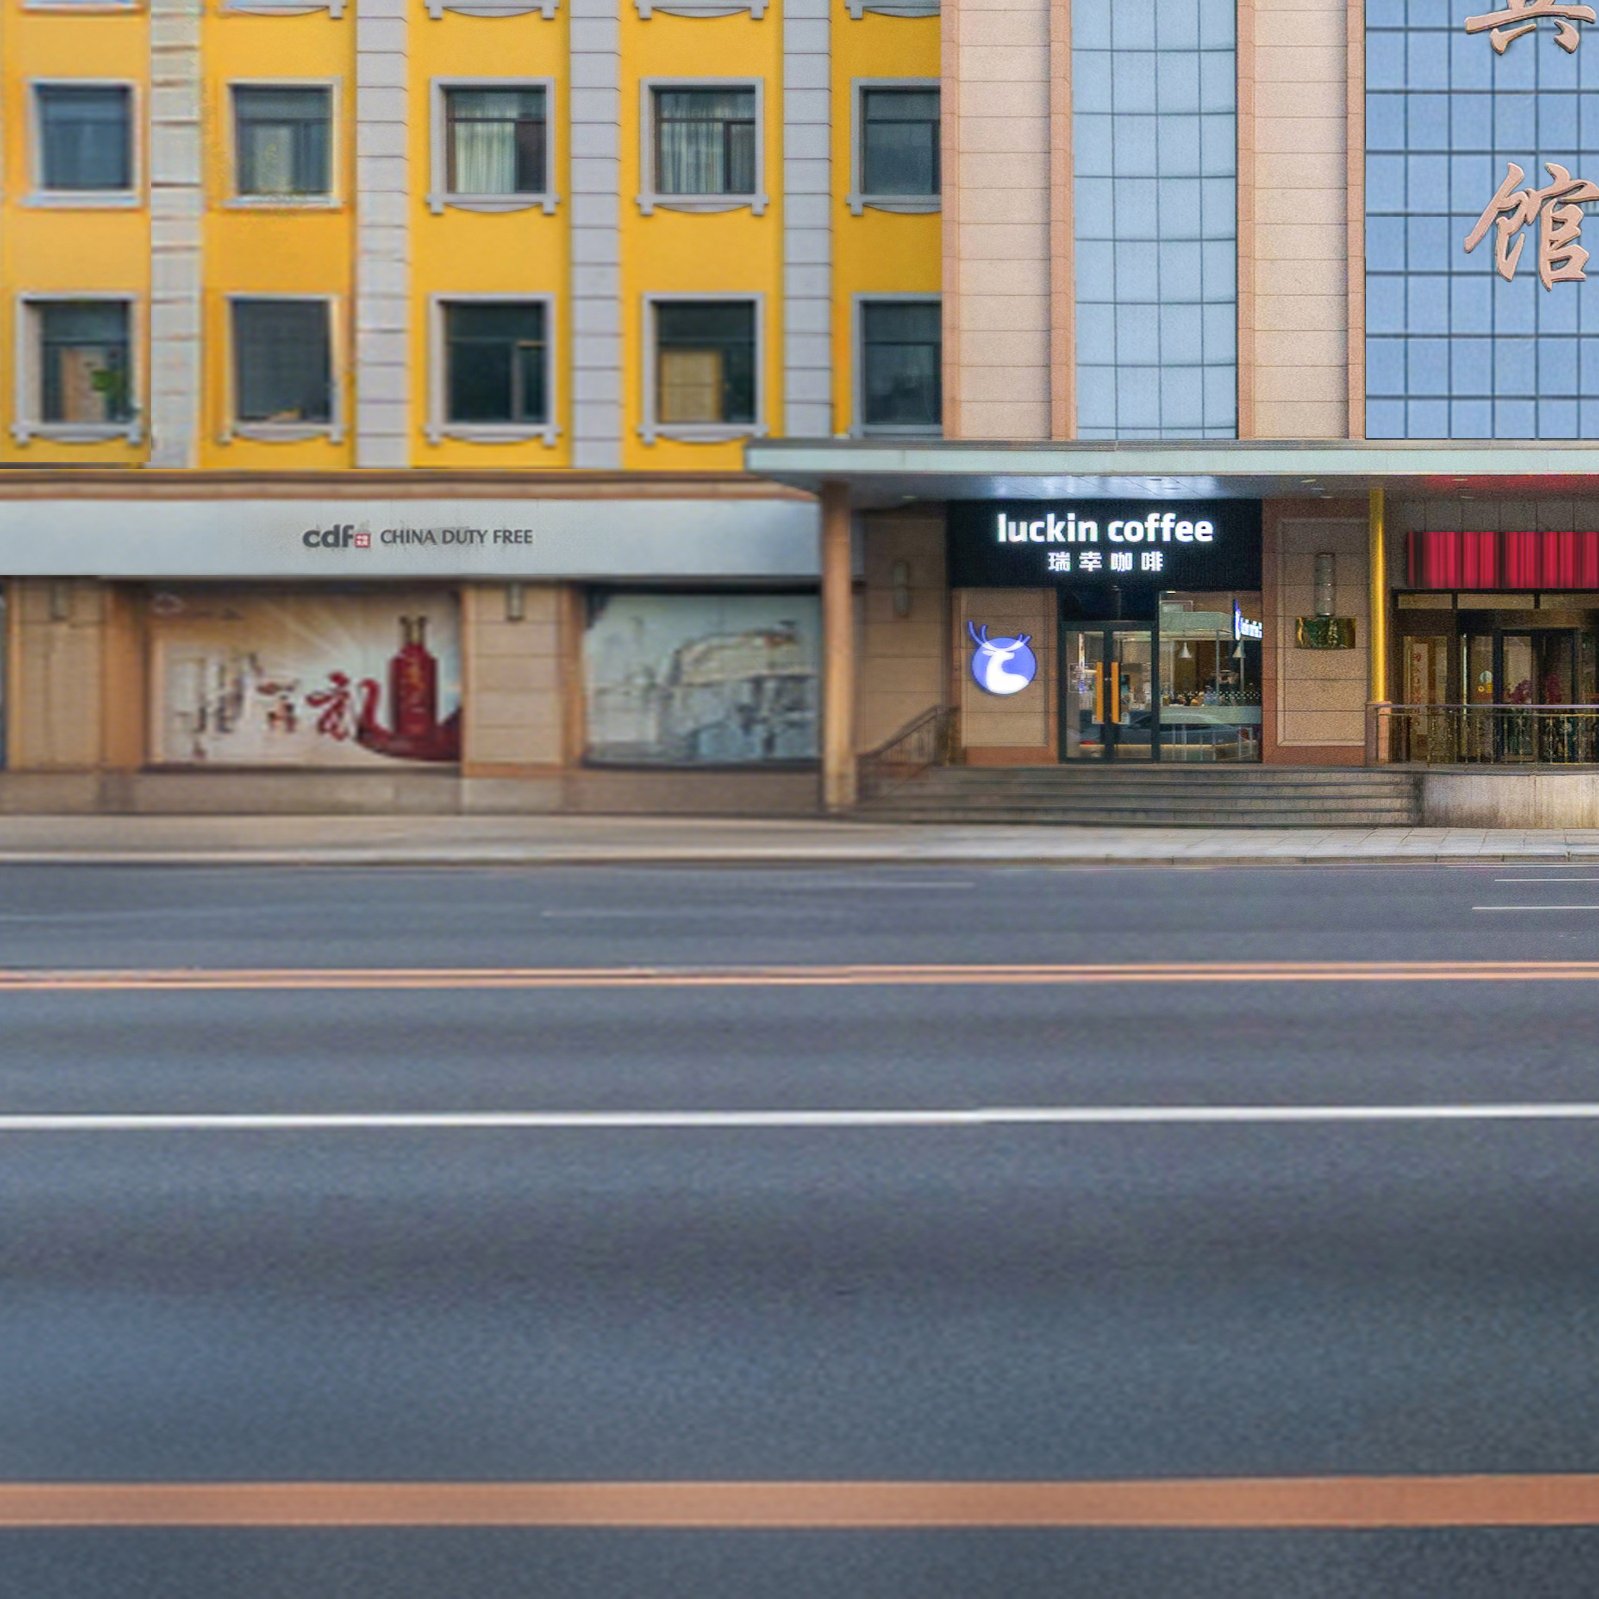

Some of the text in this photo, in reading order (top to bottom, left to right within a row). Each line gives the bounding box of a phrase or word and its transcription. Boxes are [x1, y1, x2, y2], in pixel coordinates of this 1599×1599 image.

[302, 524, 354, 548] cdf
[380, 529, 435, 545] CHINA
[442, 529, 488, 545] DUTY
[493, 529, 533, 545] FREE
[998, 513, 1214, 542] luckin coffee
[1048, 551, 1164, 572] 瑞幸咖啡
